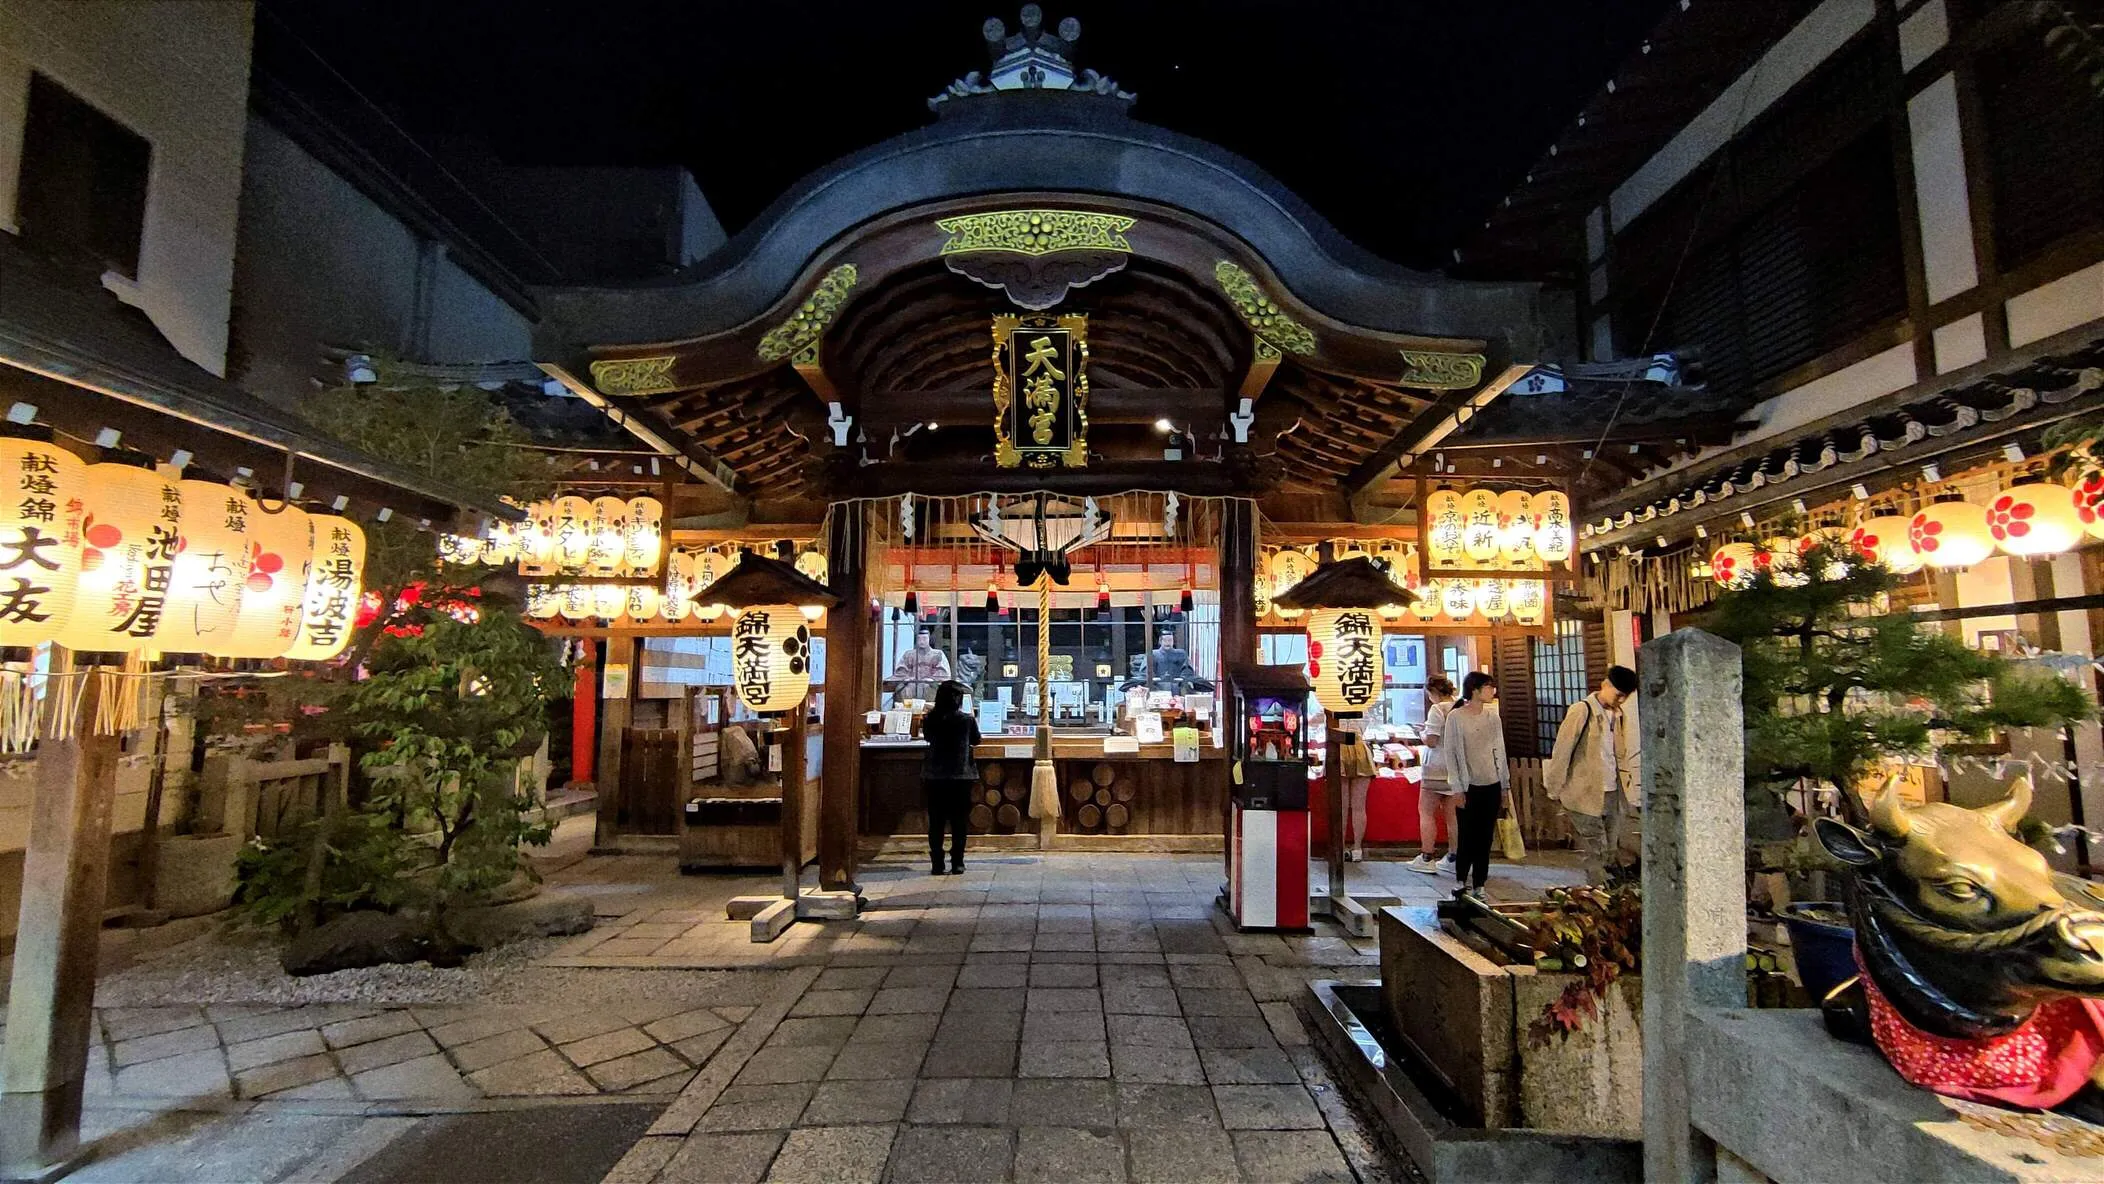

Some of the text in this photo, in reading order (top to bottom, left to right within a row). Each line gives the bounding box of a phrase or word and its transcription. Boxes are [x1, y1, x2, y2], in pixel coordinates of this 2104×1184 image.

[0, 526, 61, 624] 大友
[1472, 510, 1493, 548] 近新
[108, 525, 179, 637] 池田屋
[735, 610, 771, 706] 錦天満宮
[1333, 612, 1375, 706] 錦天満宮
